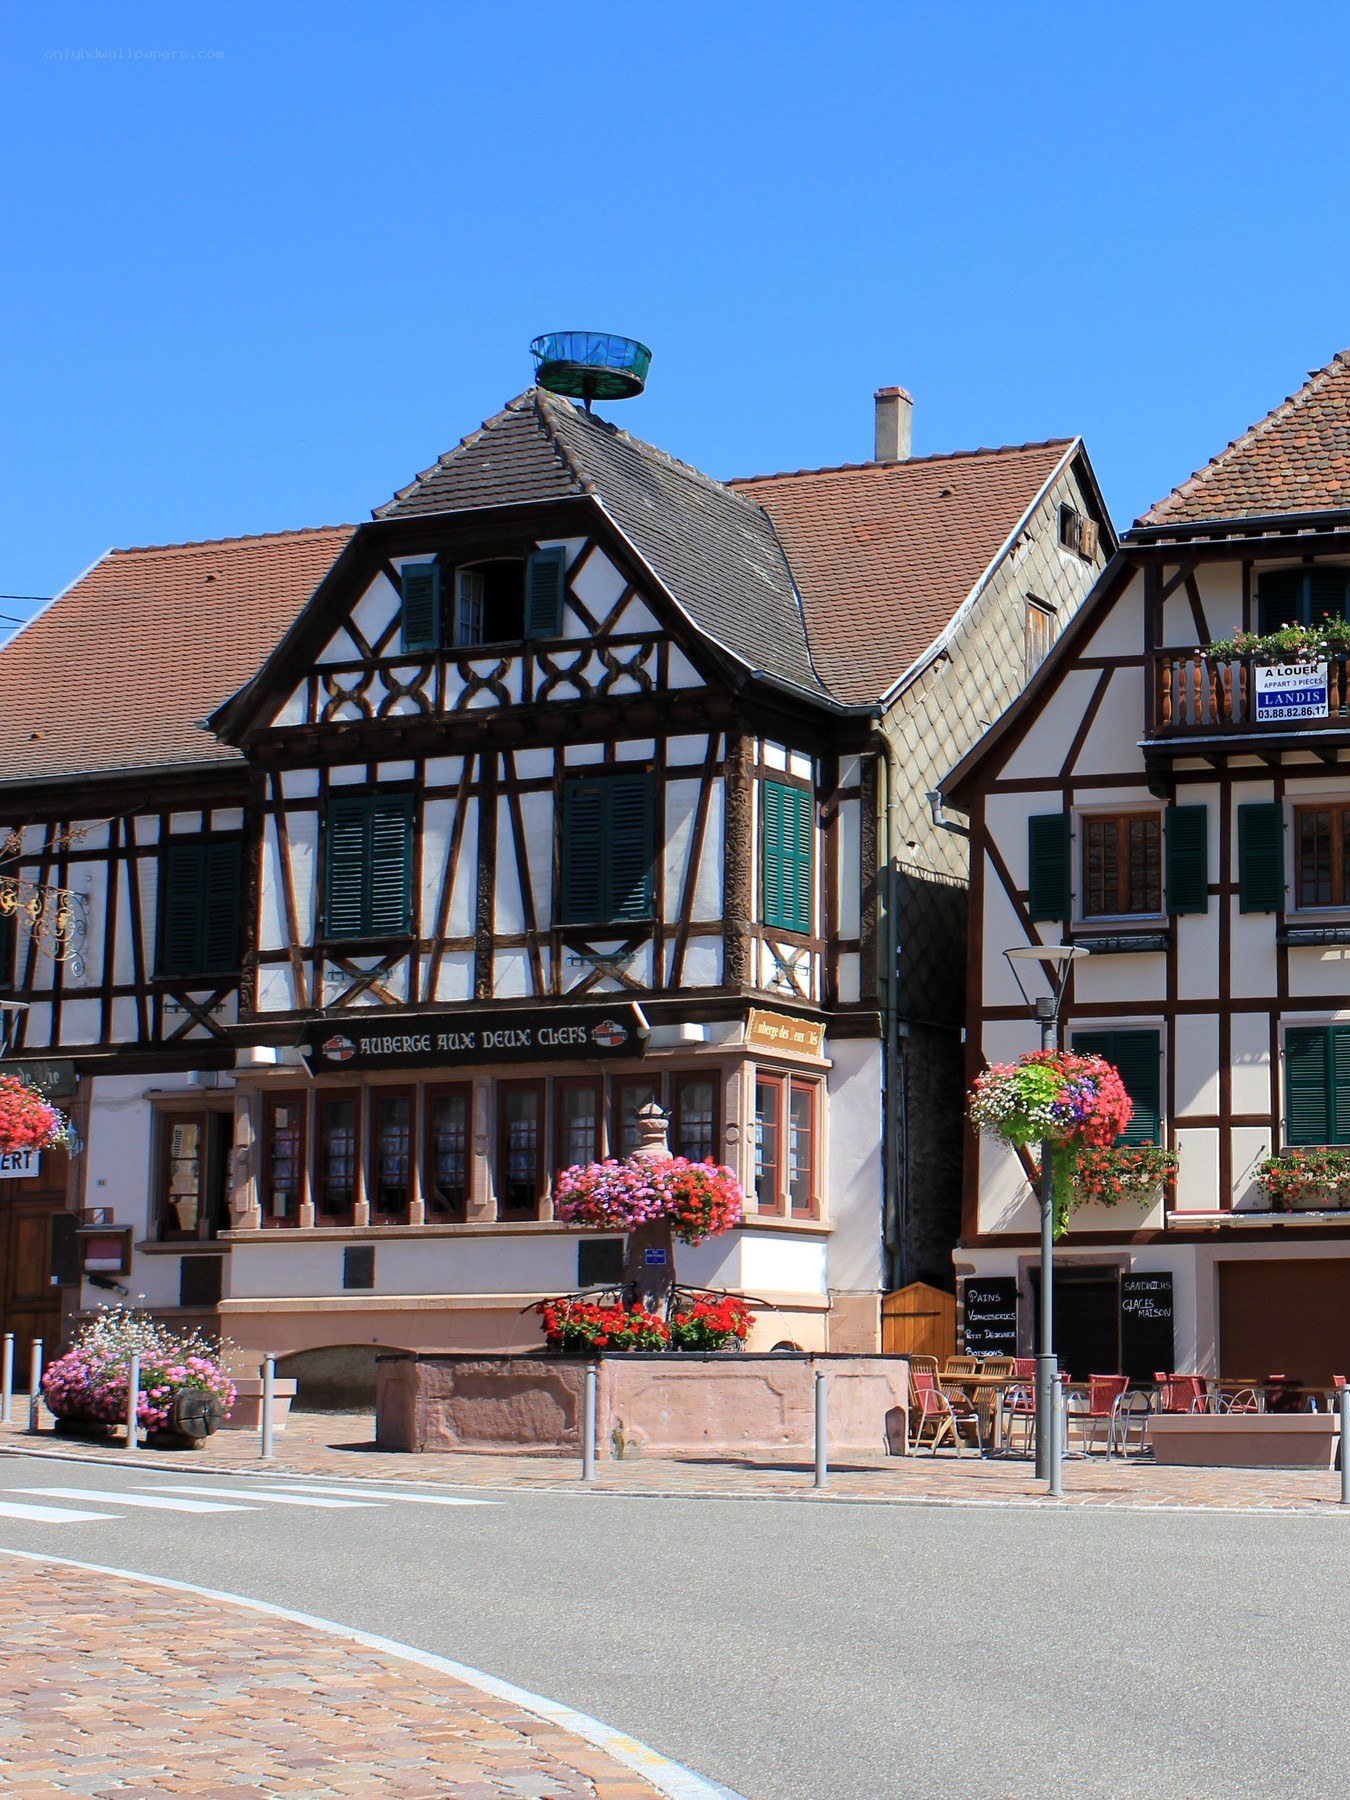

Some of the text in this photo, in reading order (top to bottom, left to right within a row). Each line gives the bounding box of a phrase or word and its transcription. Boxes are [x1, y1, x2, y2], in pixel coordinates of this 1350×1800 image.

[1265, 665, 1318, 677] A LOUER
[1264, 680, 1291, 688] APPART
[1264, 691, 1320, 705] LANDIS
[1258, 706, 1326, 719] 03.88.82.86.17
[360, 1034, 432, 1054] AUBERGE
[437, 1032, 475, 1050] AUX
[482, 1028, 532, 1049] DEUX
[538, 1026, 587, 1045] CLEFS
[968, 1290, 1001, 1302] PAINS
[1122, 1299, 1154, 1312] GLACES
[1138, 1308, 1171, 1317] MAISON
